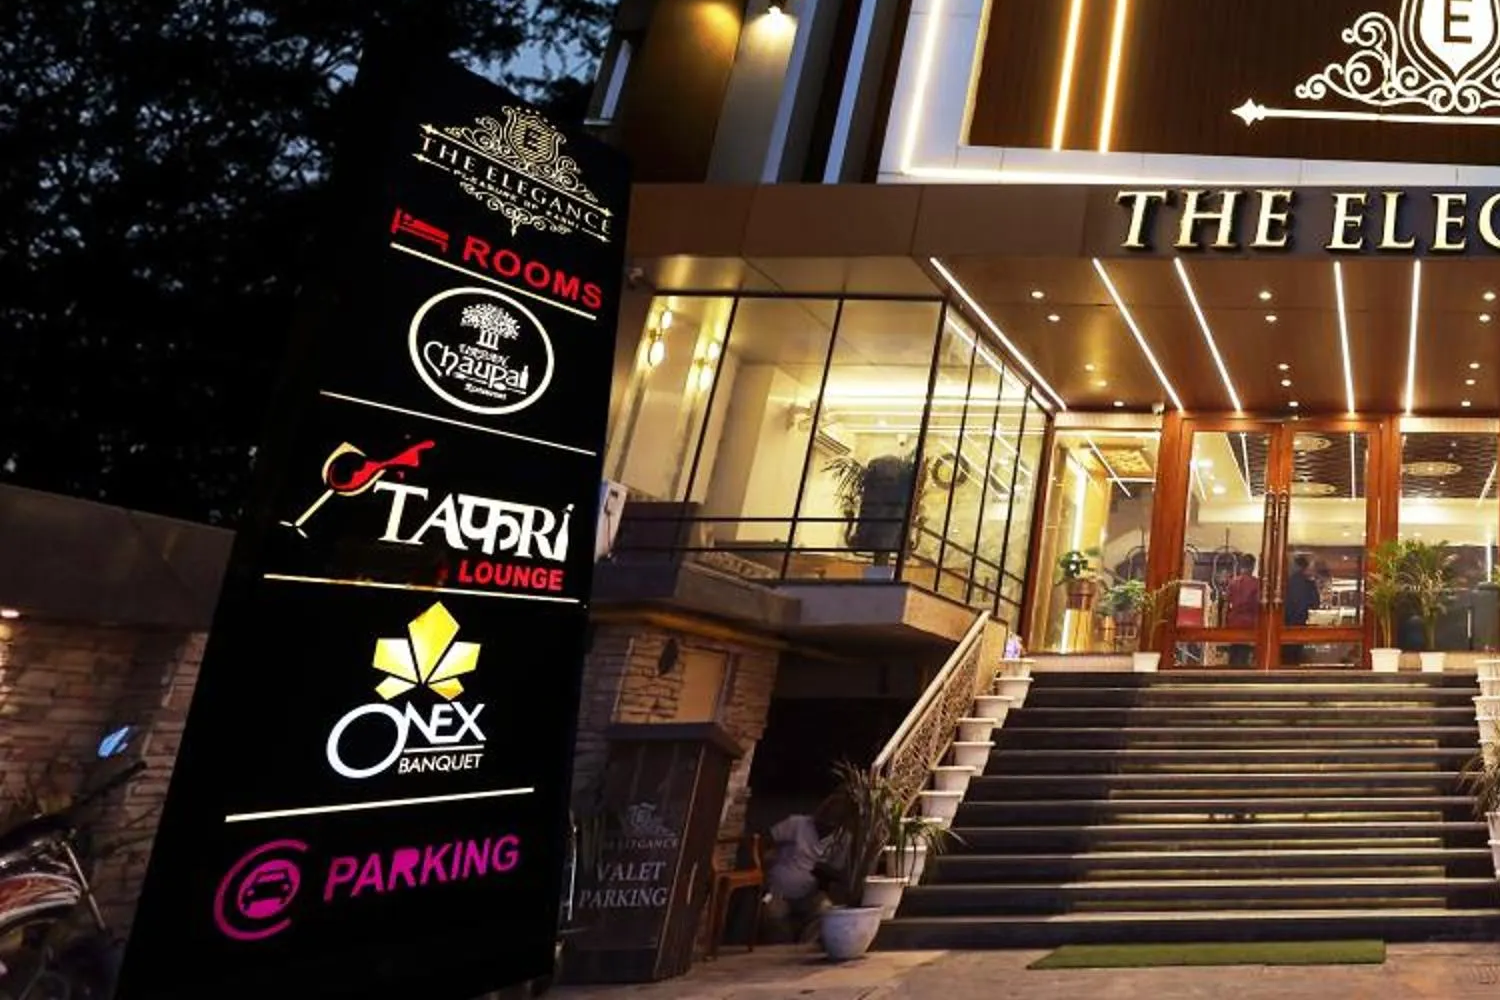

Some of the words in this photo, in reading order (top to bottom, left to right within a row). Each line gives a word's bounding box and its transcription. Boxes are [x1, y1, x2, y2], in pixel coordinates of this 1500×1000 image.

[419, 133, 477, 173] THE
[486, 165, 613, 235] ELEGANCE
[1117, 188, 1294, 250] THE
[462, 235, 603, 310] ROOMS
[458, 559, 566, 592] LOUNGE
[326, 700, 487, 779] ONEX
[398, 752, 484, 775] BANQUET
[323, 833, 521, 904] PARKING
[578, 886, 668, 909] PARKING
[596, 861, 668, 881] VALET
